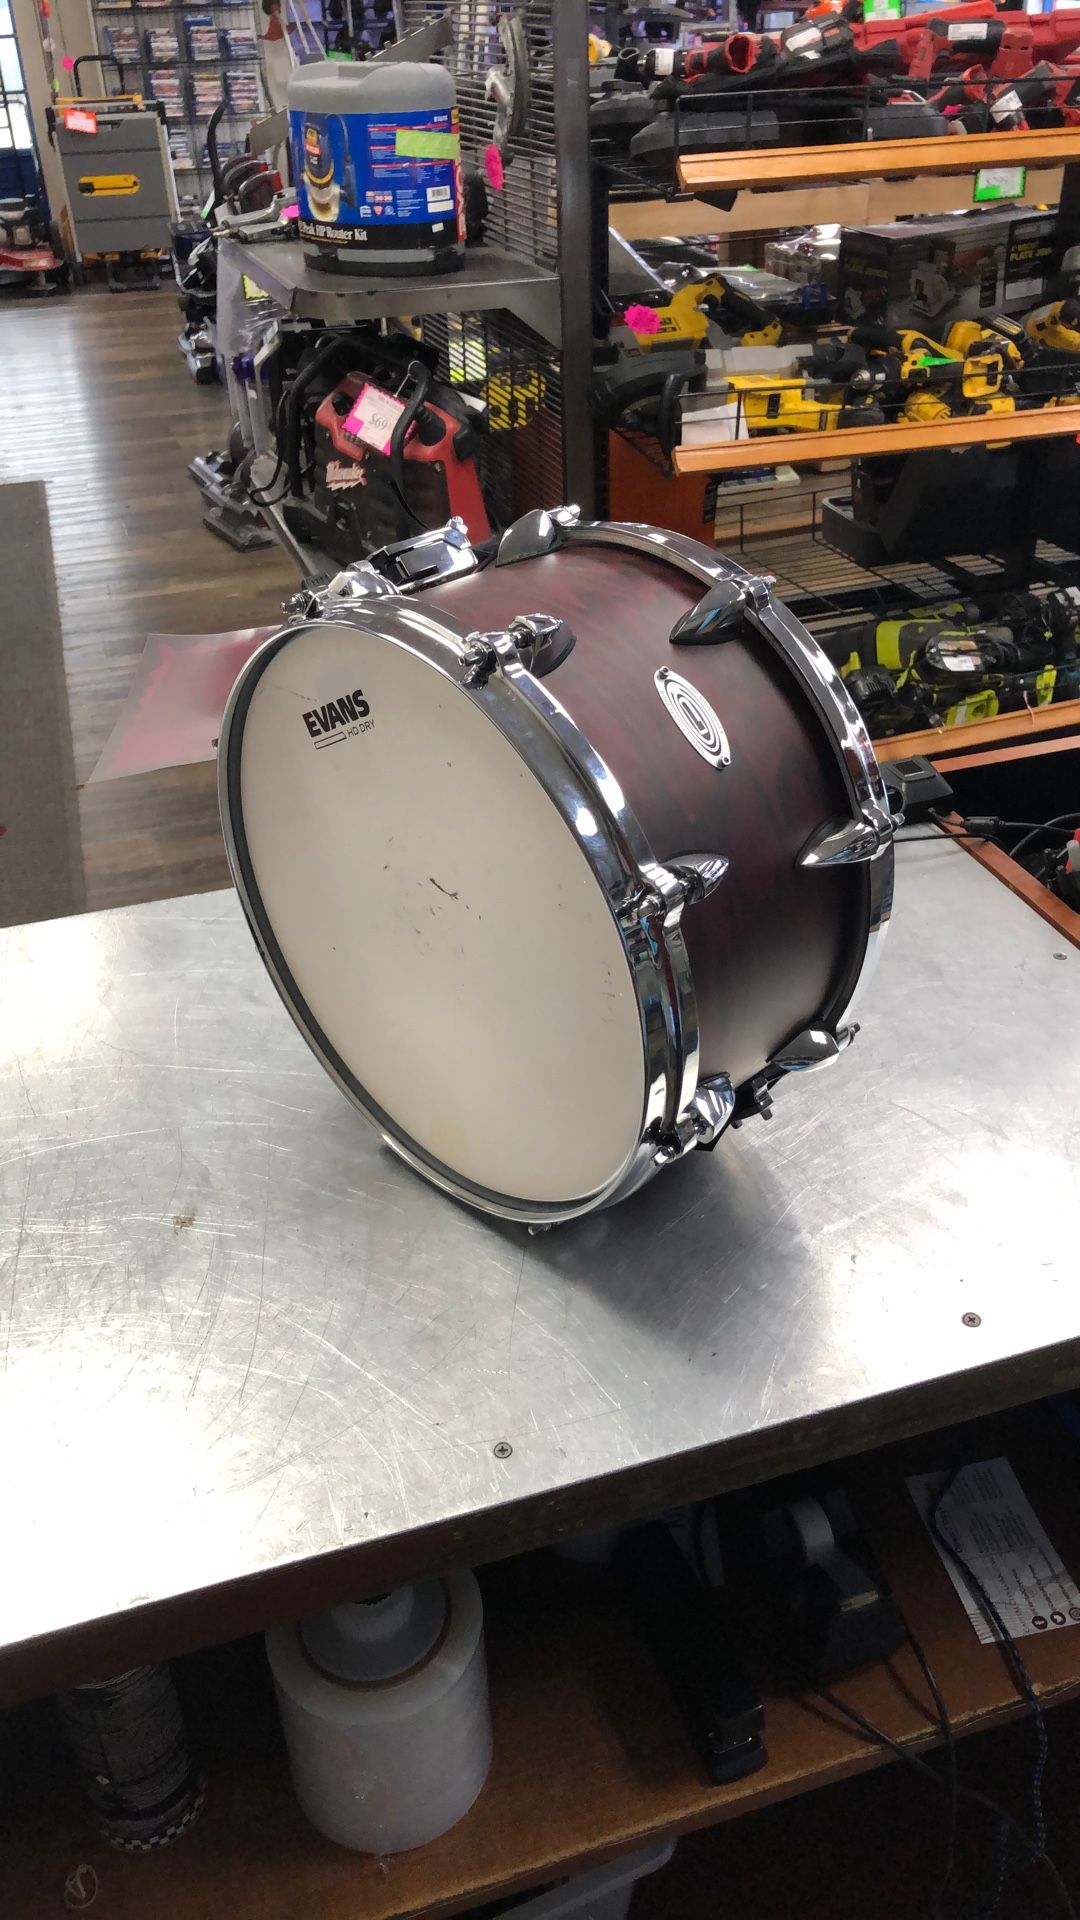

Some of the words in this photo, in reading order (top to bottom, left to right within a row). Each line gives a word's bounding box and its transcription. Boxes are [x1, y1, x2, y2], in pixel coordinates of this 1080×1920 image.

[326, 226, 353, 240] Router
[354, 228, 369, 241] Kit
[302, 689, 370, 738] EVANS
[346, 726, 359, 738] HD
[358, 718, 375, 733] DRY
